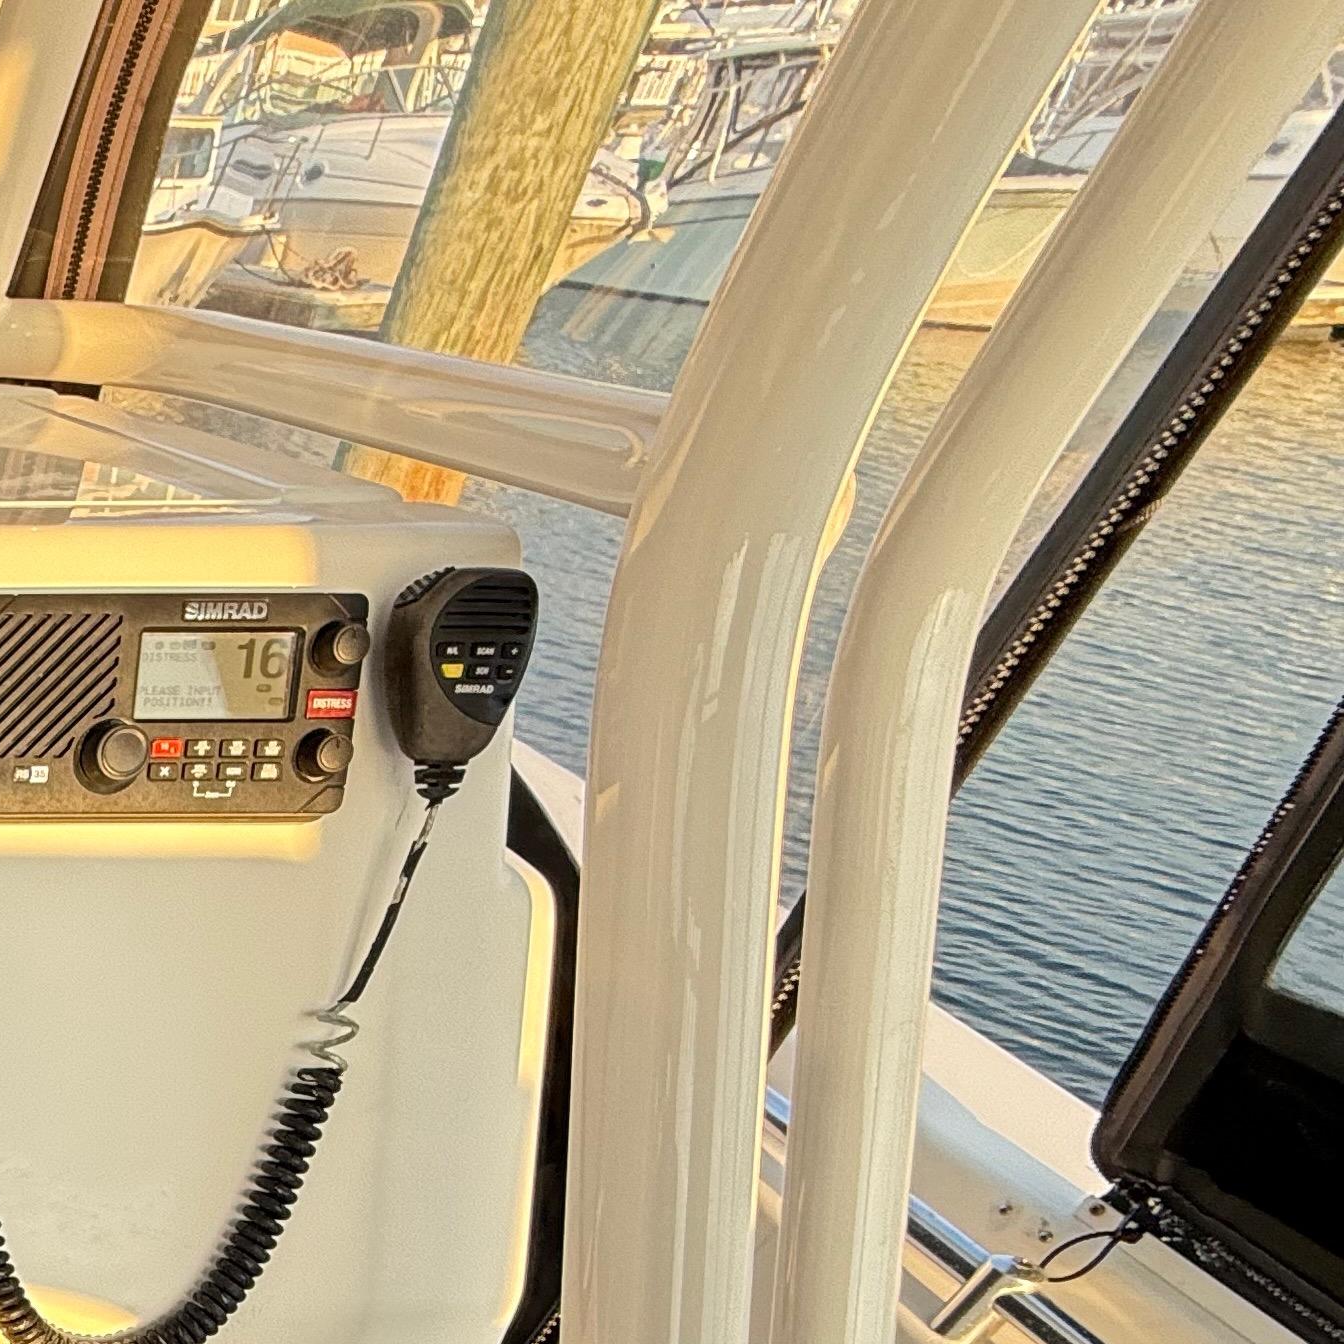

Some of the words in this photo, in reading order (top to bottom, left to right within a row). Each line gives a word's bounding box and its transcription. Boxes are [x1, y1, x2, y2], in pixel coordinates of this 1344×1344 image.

[184, 602, 268, 620] SIMRAD
[237, 638, 288, 679] 16
[455, 685, 494, 693] SIMRAD
[313, 699, 351, 709] DISTRESS
